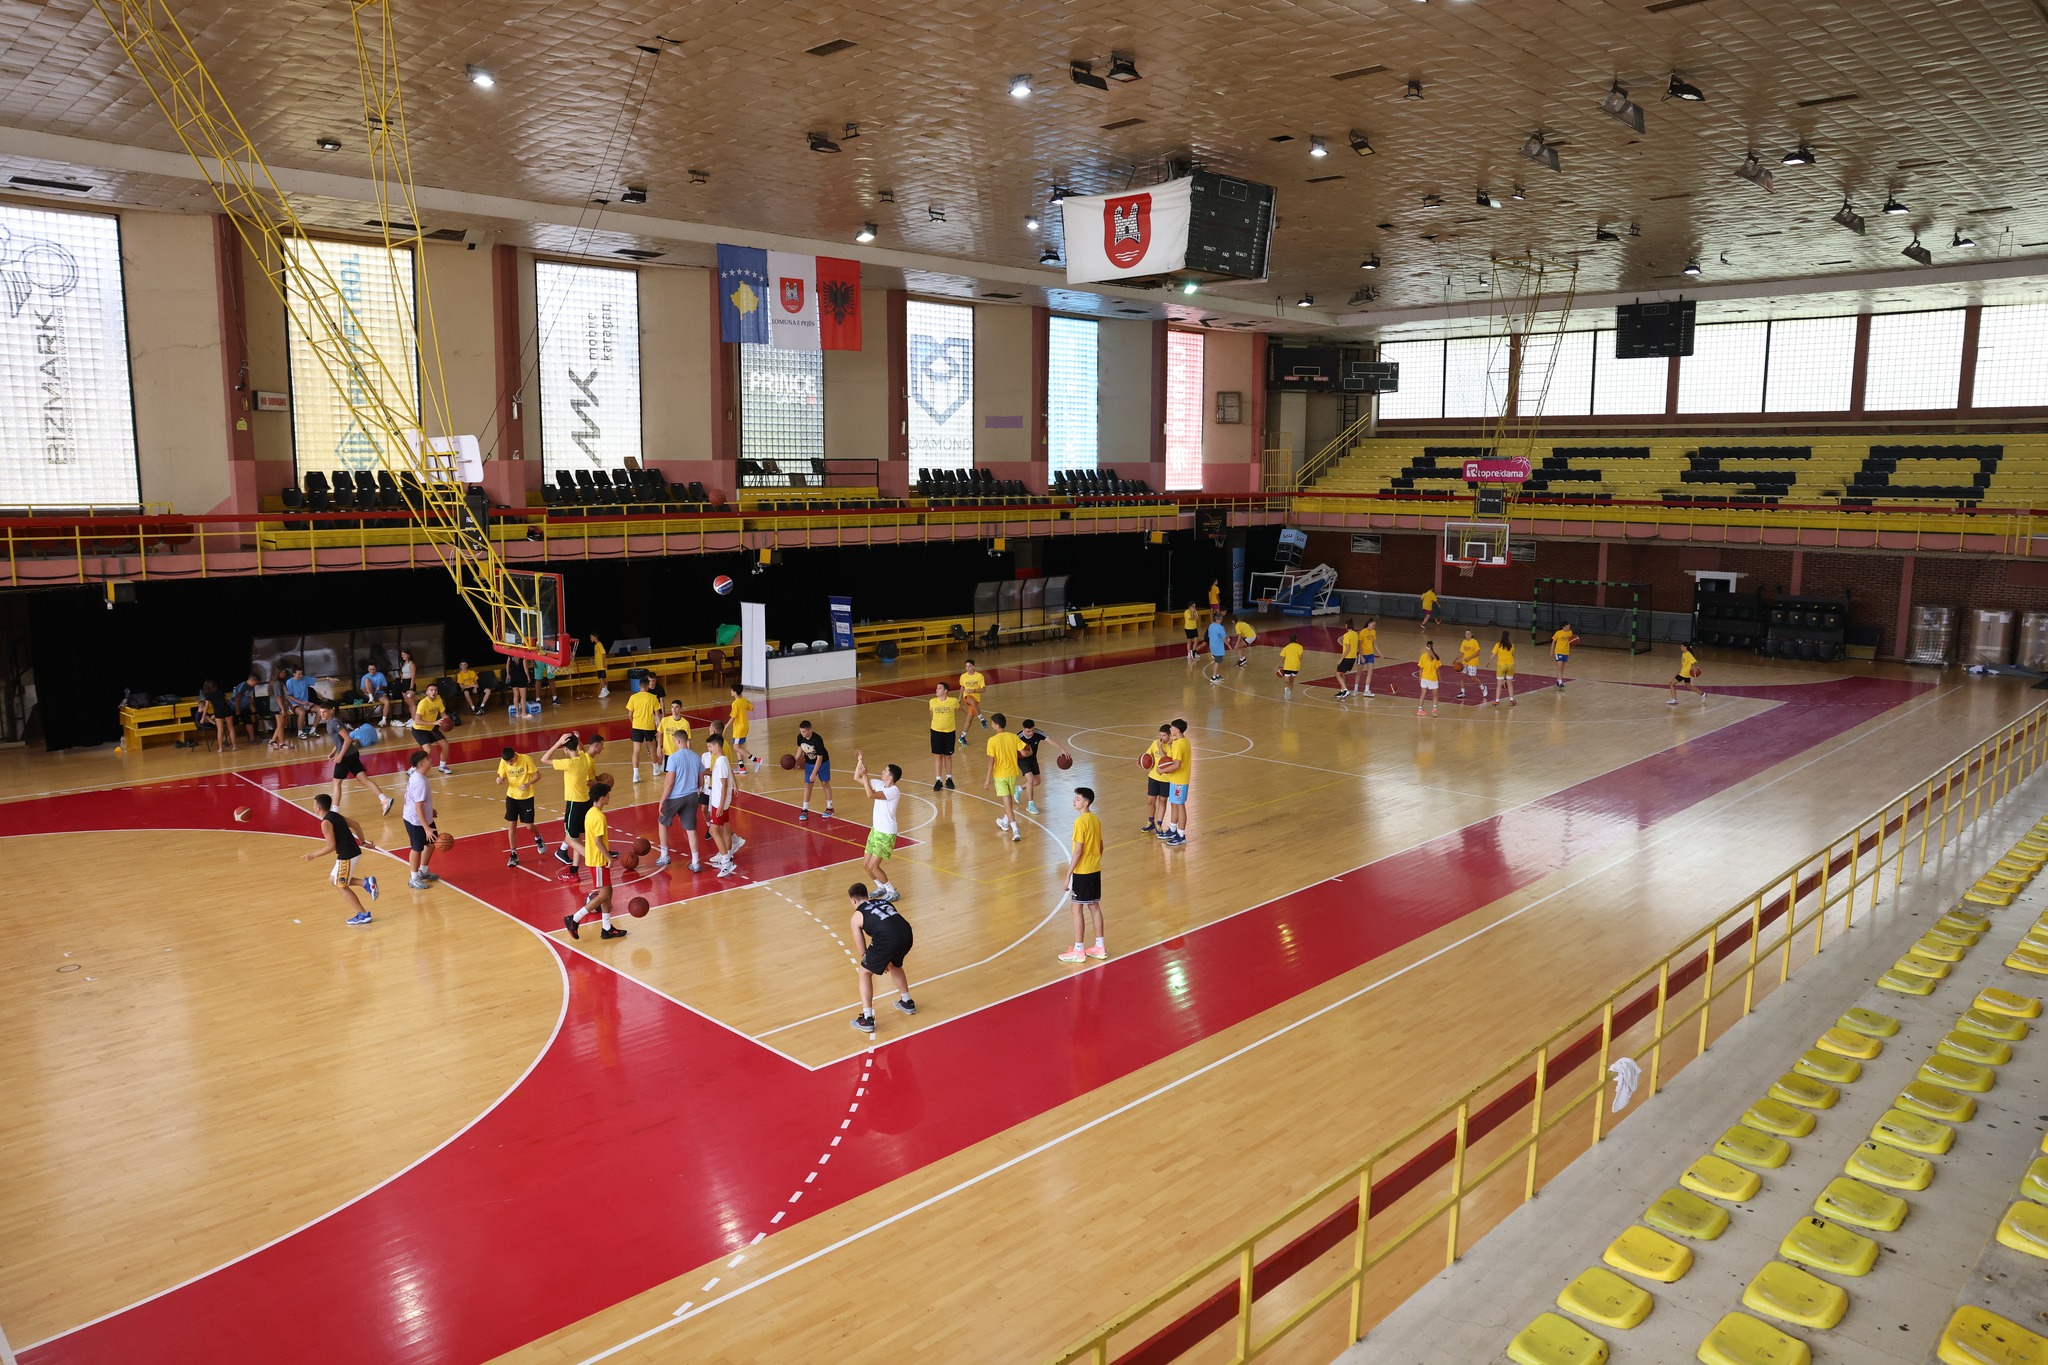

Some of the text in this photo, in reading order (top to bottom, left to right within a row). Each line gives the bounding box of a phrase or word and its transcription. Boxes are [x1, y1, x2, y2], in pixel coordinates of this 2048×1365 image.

[340, 252, 364, 353] PETROL
[587, 312, 598, 361] mobile
[33, 308, 68, 465] BIZMARK
[751, 373, 817, 396] PRINCE
[260, 396, 287, 407] NO SMOKING
[908, 437, 971, 451] DIAMOND
[1478, 470, 1524, 479] topreklama
[871, 904, 899, 920] 12
